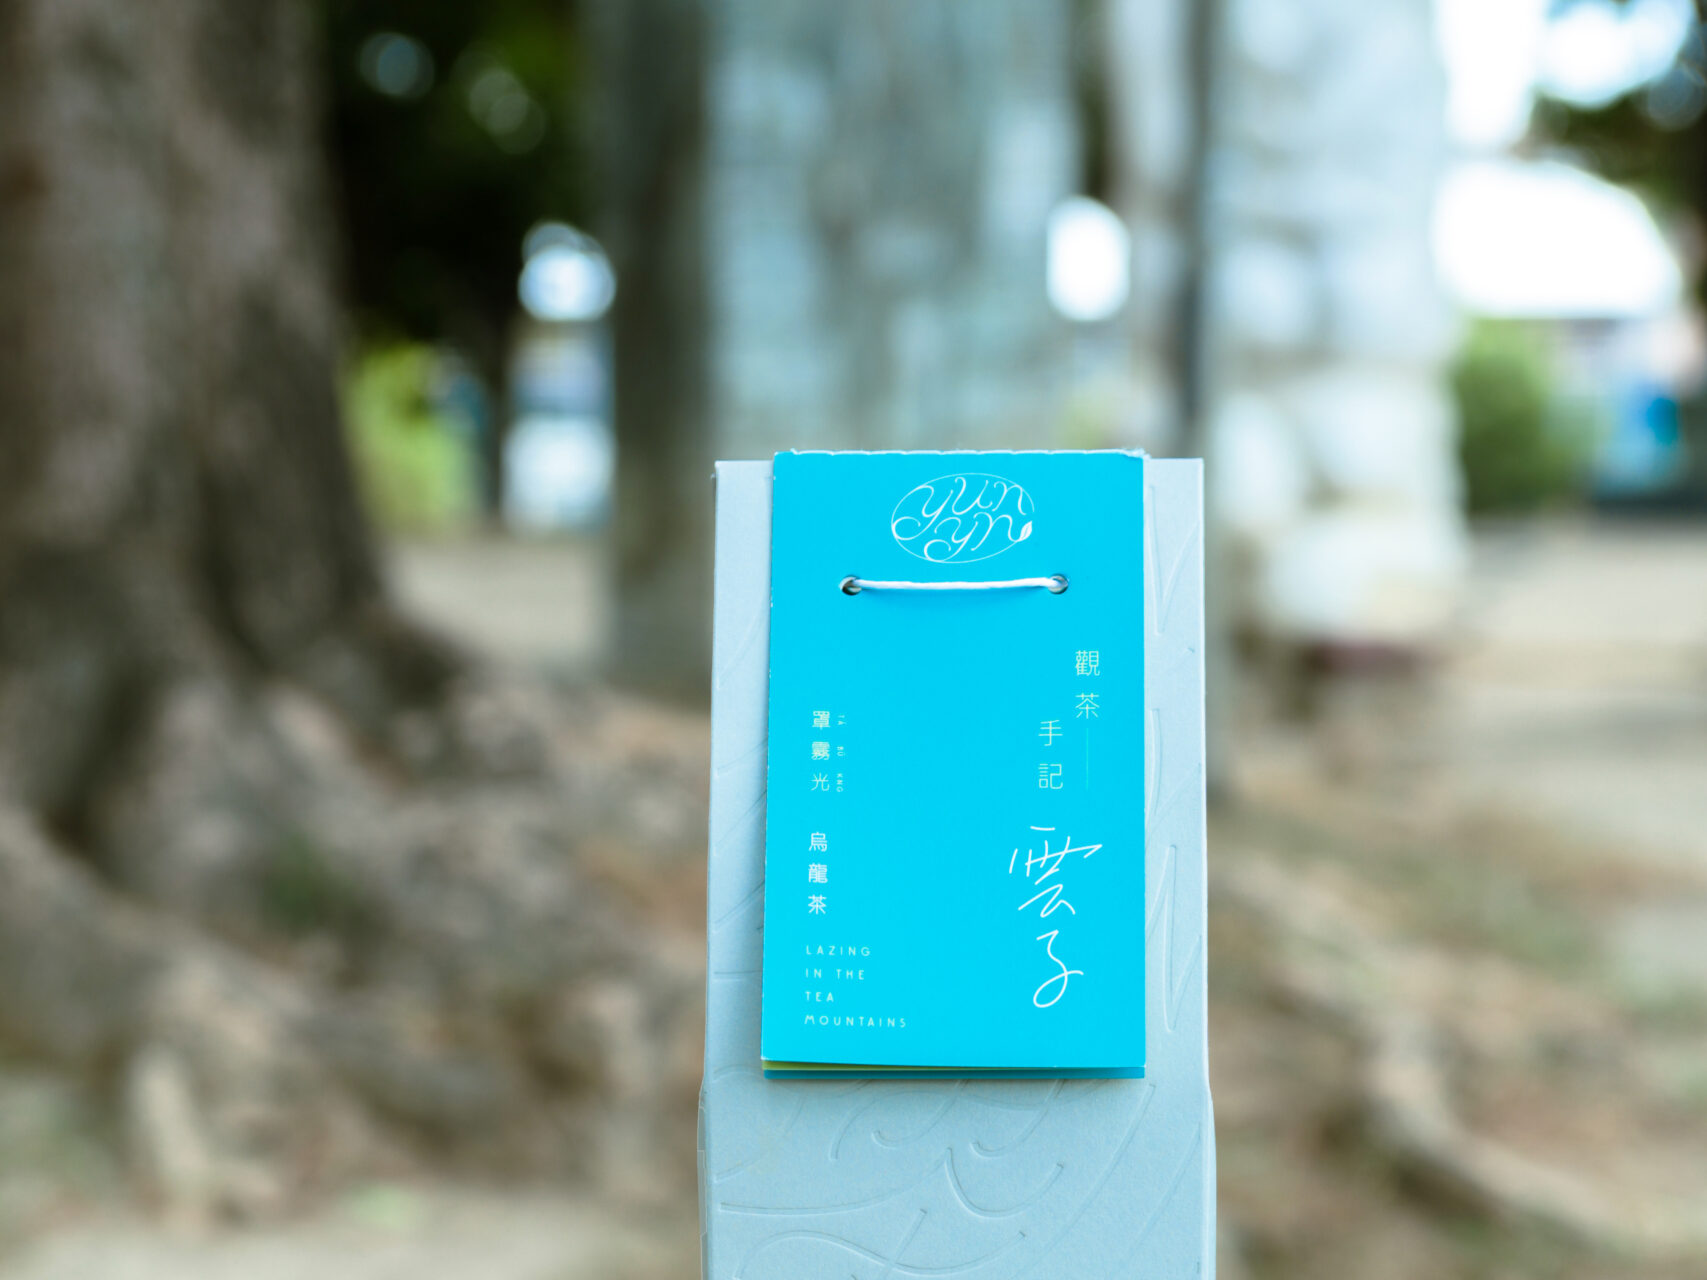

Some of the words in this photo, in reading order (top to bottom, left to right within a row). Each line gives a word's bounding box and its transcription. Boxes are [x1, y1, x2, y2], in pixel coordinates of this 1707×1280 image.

[1074, 649, 1101, 720] 觀茶
[810, 710, 831, 792] 罩霧光
[1037, 719, 1064, 790] 手記
[807, 831, 829, 915] 烏龍茶
[805, 944, 871, 957] LAZING
[805, 967, 822, 979] IN
[836, 968, 865, 981] THE
[804, 990, 834, 1003] TEA
[803, 1014, 906, 1028] MOUNTAINS
